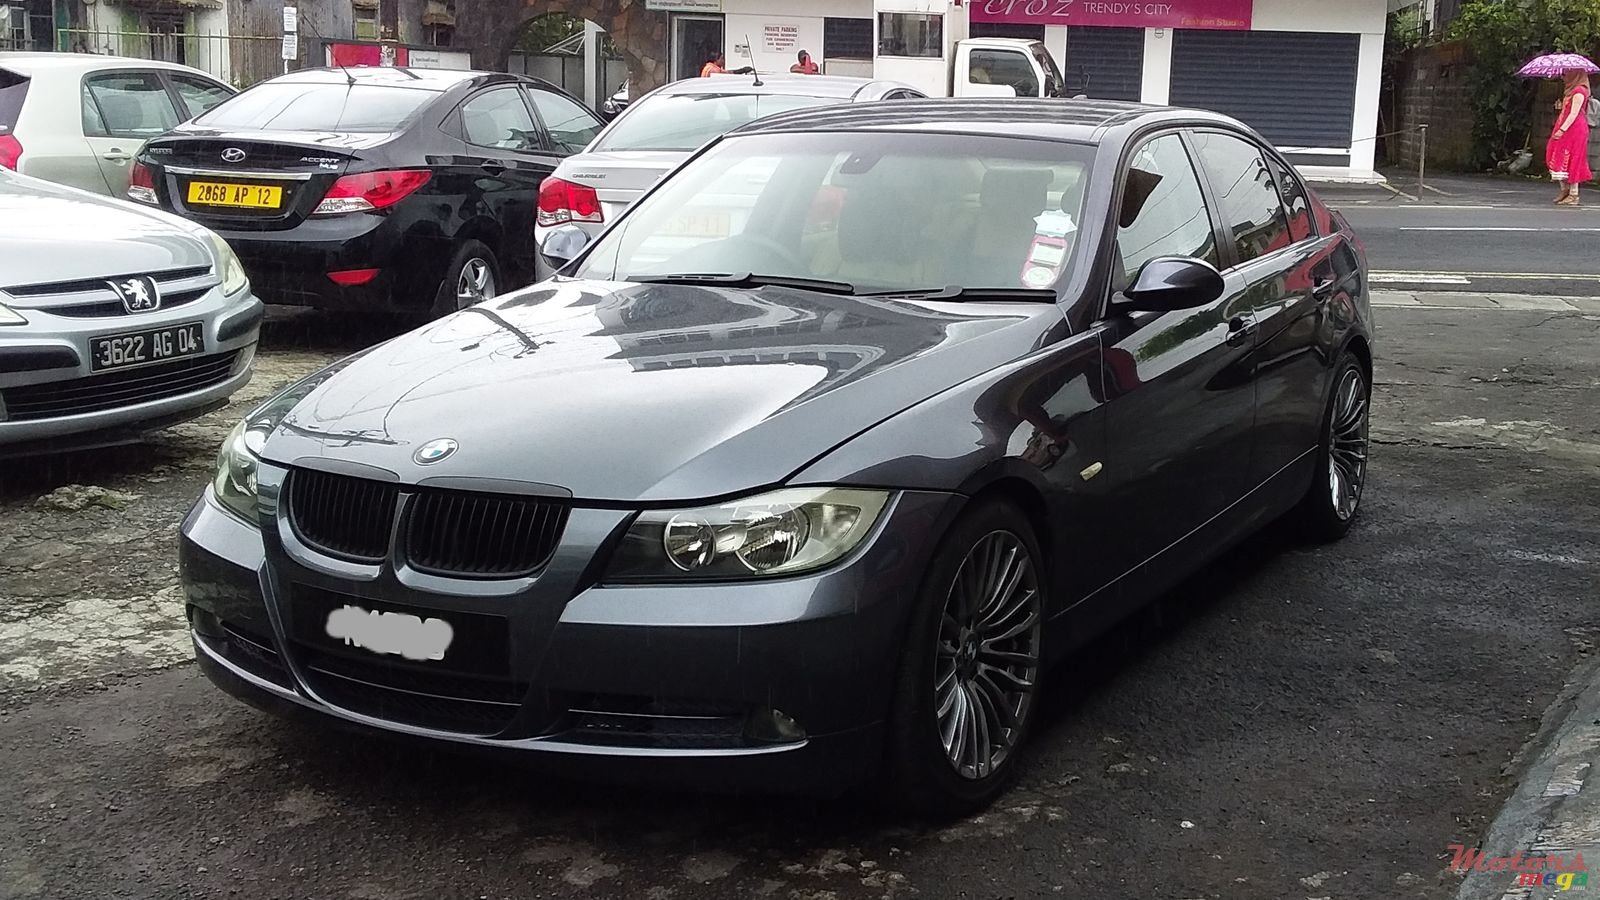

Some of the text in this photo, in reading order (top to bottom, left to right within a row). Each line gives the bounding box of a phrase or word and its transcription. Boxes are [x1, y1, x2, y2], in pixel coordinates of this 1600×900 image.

[1083, 1, 1141, 15] TRENDY'S
[1144, 3, 1172, 16] CITY
[299, 156, 340, 164] ACCENT
[197, 184, 271, 205] 2868 AP 12
[99, 327, 198, 366] 3622 AG 04
